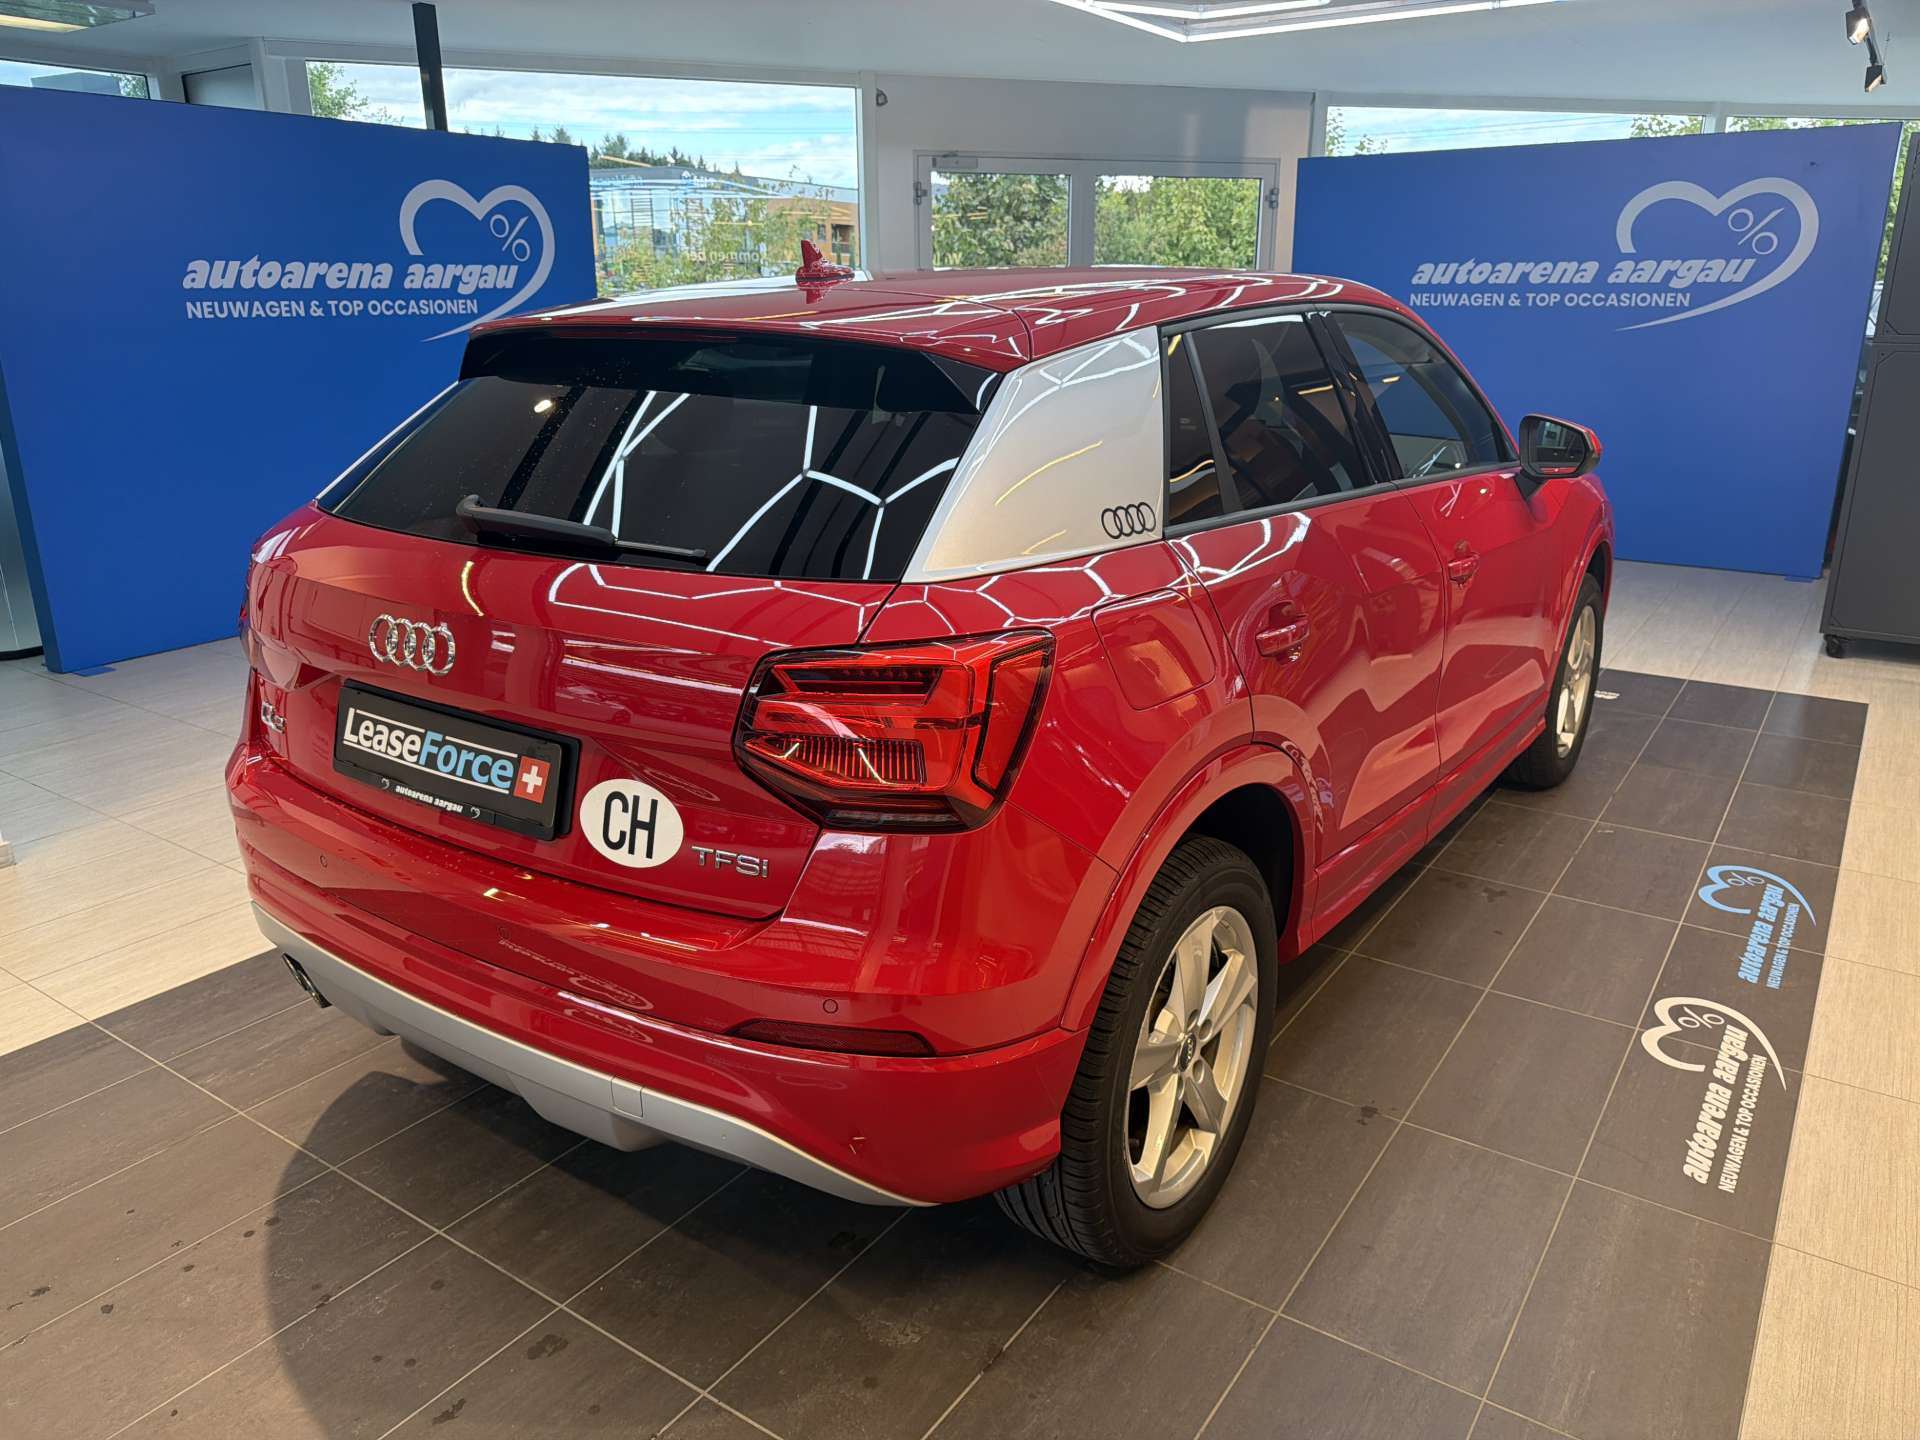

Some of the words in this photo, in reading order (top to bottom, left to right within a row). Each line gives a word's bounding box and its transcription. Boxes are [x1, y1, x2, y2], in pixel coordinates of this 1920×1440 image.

[182, 254, 394, 290] autoarena
[403, 261, 519, 295] aargau
[1411, 257, 1599, 285] autoarena
[1607, 257, 1756, 289] aargau
[186, 300, 306, 319] NEUWAGEN
[310, 301, 325, 317] &
[327, 300, 364, 316] TOP
[368, 298, 478, 316] OCCASIONEN
[1409, 293, 1504, 307] NEUWAGEN
[1508, 293, 1522, 307] &
[1526, 293, 1561, 307] TOP
[1564, 292, 1691, 308] OCCASIONEN
[343, 707, 515, 790] LeaseForce
[395, 785, 433, 804] autoarena
[433, 798, 463, 813] aargau
[602, 790, 659, 859] CH
[691, 845, 769, 878] TFSI
[1738, 920, 1774, 984] autoarena
[1757, 883, 1786, 922] aargau
[1776, 935, 1792, 949] TOP
[1765, 952, 1788, 990] NEUWAGEN
[1738, 1052, 1767, 1110] OCCASIONEN
[1682, 1082, 1732, 1184] autoarena
[1712, 1024, 1749, 1085] aargau
[1734, 1106, 1754, 1128] TOP
[1731, 1125, 1750, 1137] &
[1717, 1132, 1748, 1194] NEUWAGEN
